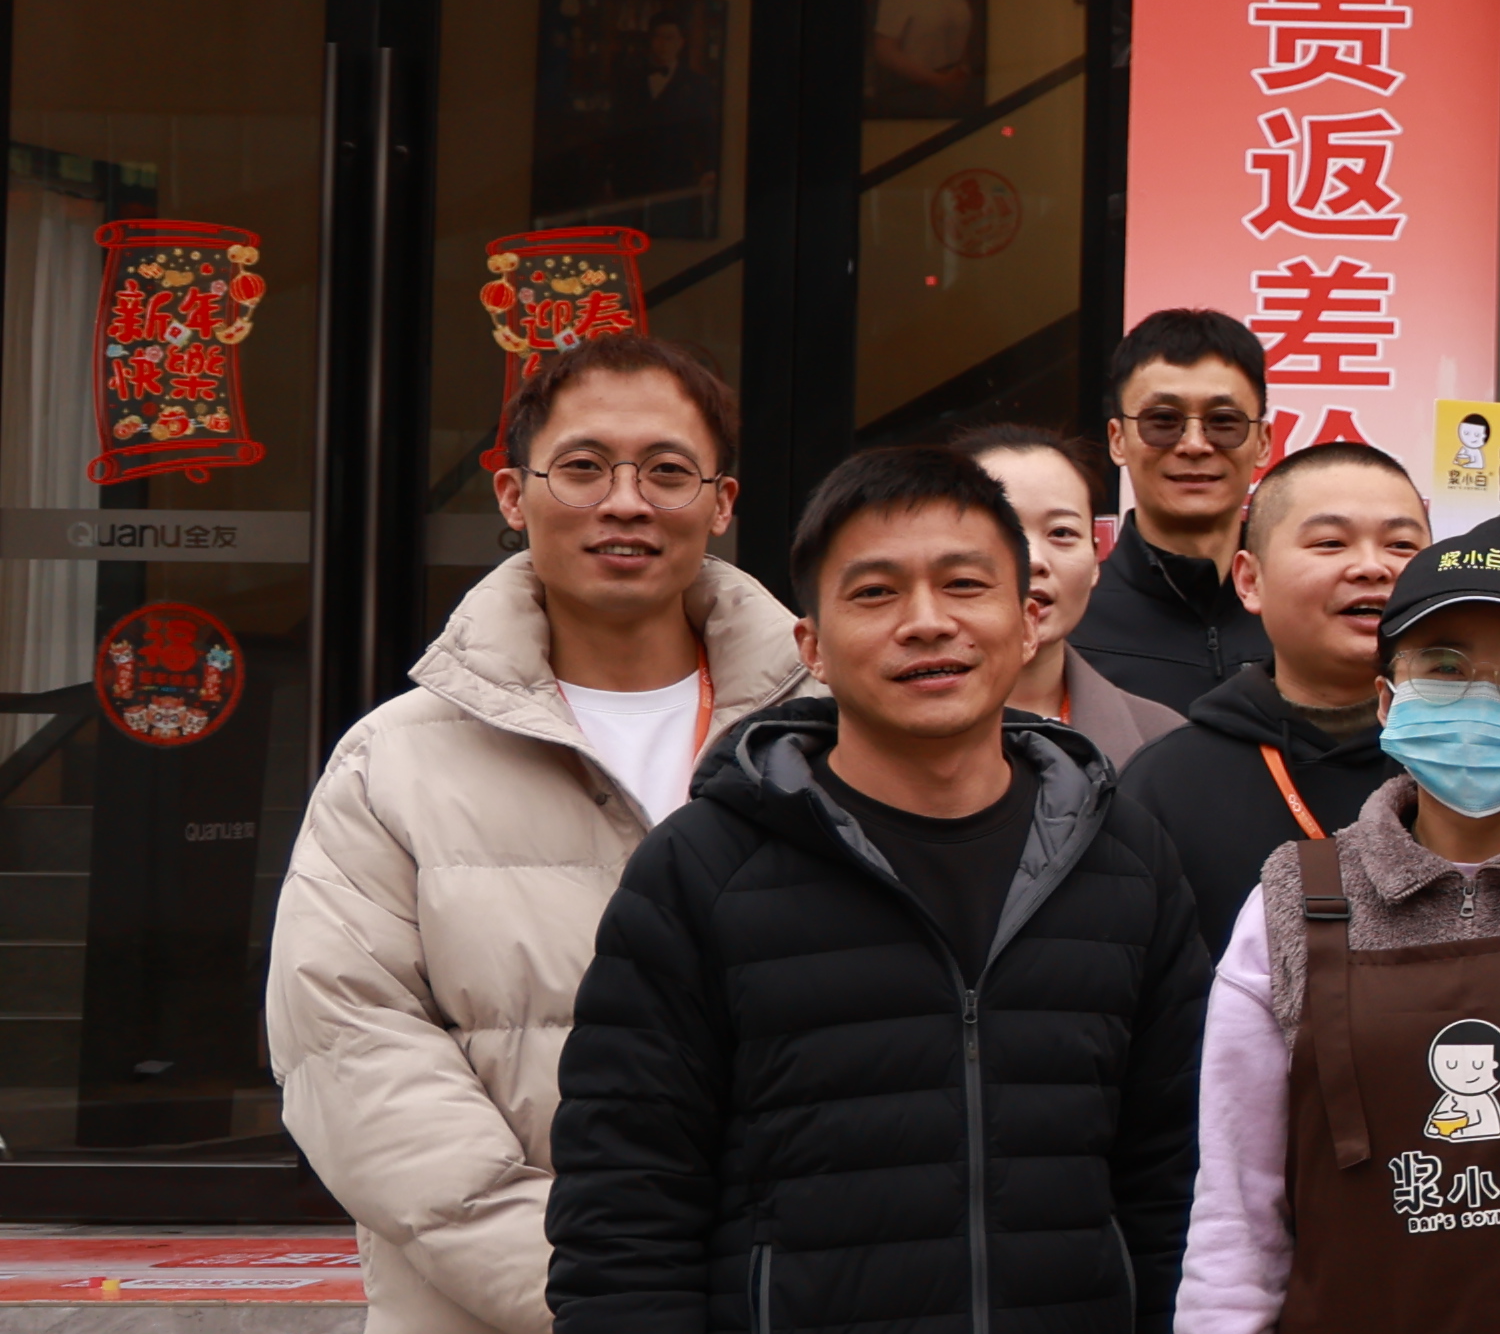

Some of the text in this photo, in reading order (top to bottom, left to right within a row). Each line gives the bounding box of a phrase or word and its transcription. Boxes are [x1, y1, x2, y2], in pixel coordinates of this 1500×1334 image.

[107, 278, 226, 344] 新年
[1447, 469, 1488, 487] 浆小白
[1407, 1212, 1456, 1234] BAI'S
